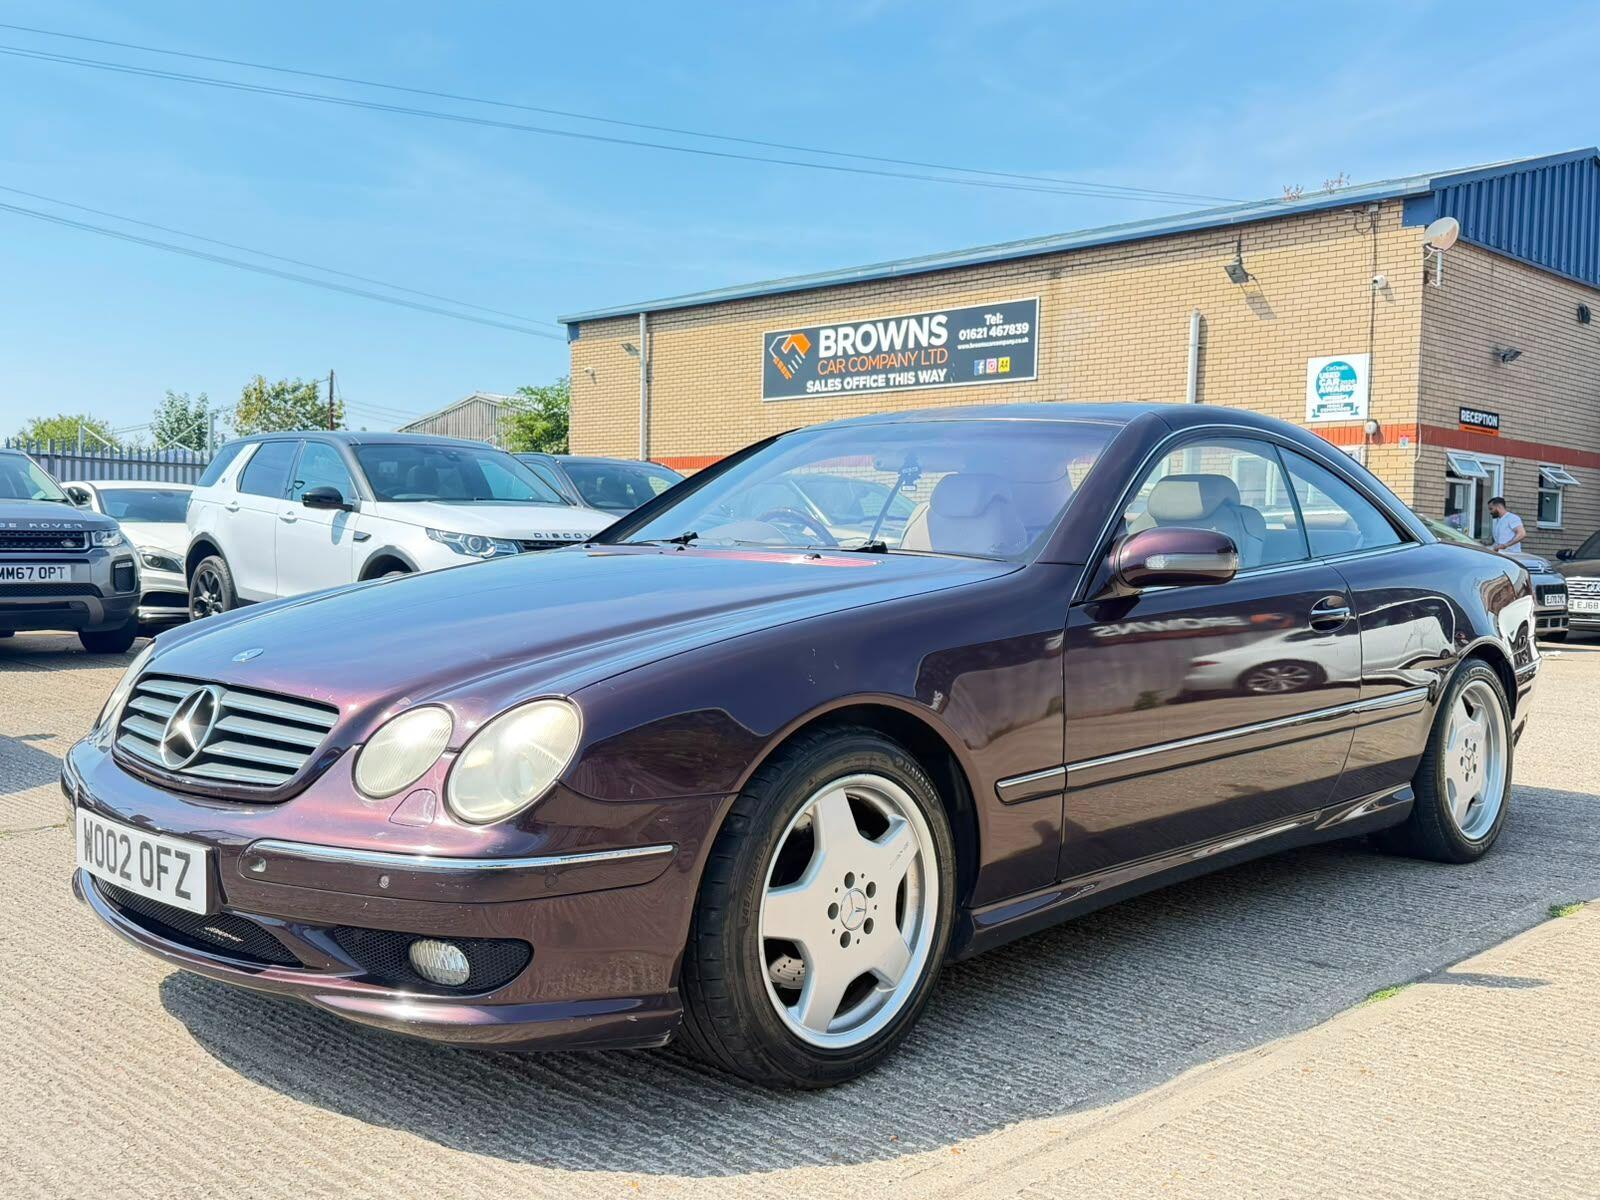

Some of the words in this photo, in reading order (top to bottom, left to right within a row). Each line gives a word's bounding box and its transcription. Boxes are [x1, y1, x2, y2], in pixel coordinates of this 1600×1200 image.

[984, 312, 1003, 325] Tel:
[818, 314, 949, 358] BROWNS
[958, 327, 988, 341] 01621
[988, 322, 1030, 337] 467839
[817, 359, 846, 376] CAR
[848, 350, 918, 373] COMPANY
[920, 348, 948, 366] LTD
[806, 379, 842, 393] SALES
[843, 374, 886, 390] OFFICE
[887, 371, 915, 387] THIS
[917, 368, 947, 384] WAY
[1318, 378, 1340, 386] CAR
[1461, 409, 1498, 427] RECEPTION
[38, 566, 65, 580] OPT
[139, 840, 192, 901] OFZ
